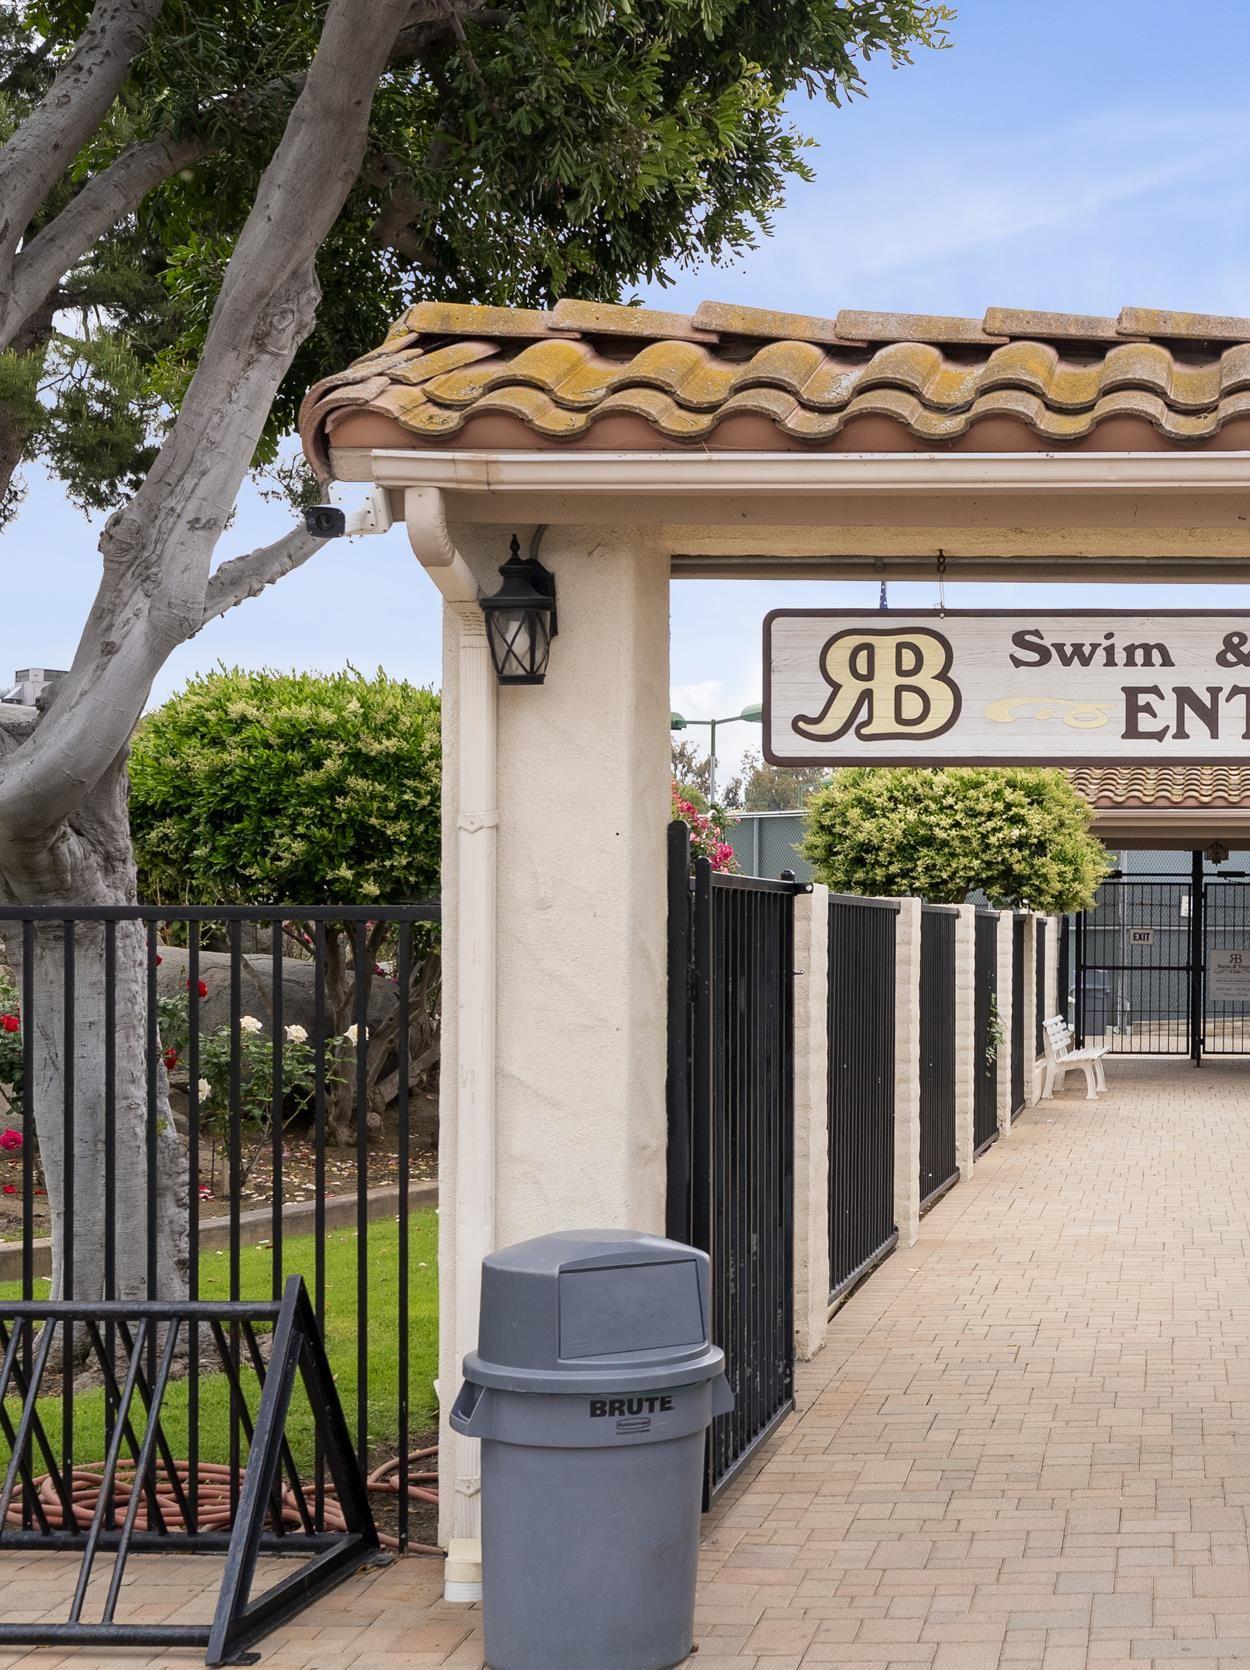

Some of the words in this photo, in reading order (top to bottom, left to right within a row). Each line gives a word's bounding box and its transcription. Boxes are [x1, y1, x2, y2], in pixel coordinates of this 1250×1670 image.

[1008, 628, 1176, 669] Swim
[1133, 932, 1151, 941] EXIT
[590, 1396, 674, 1417] BRUTE
